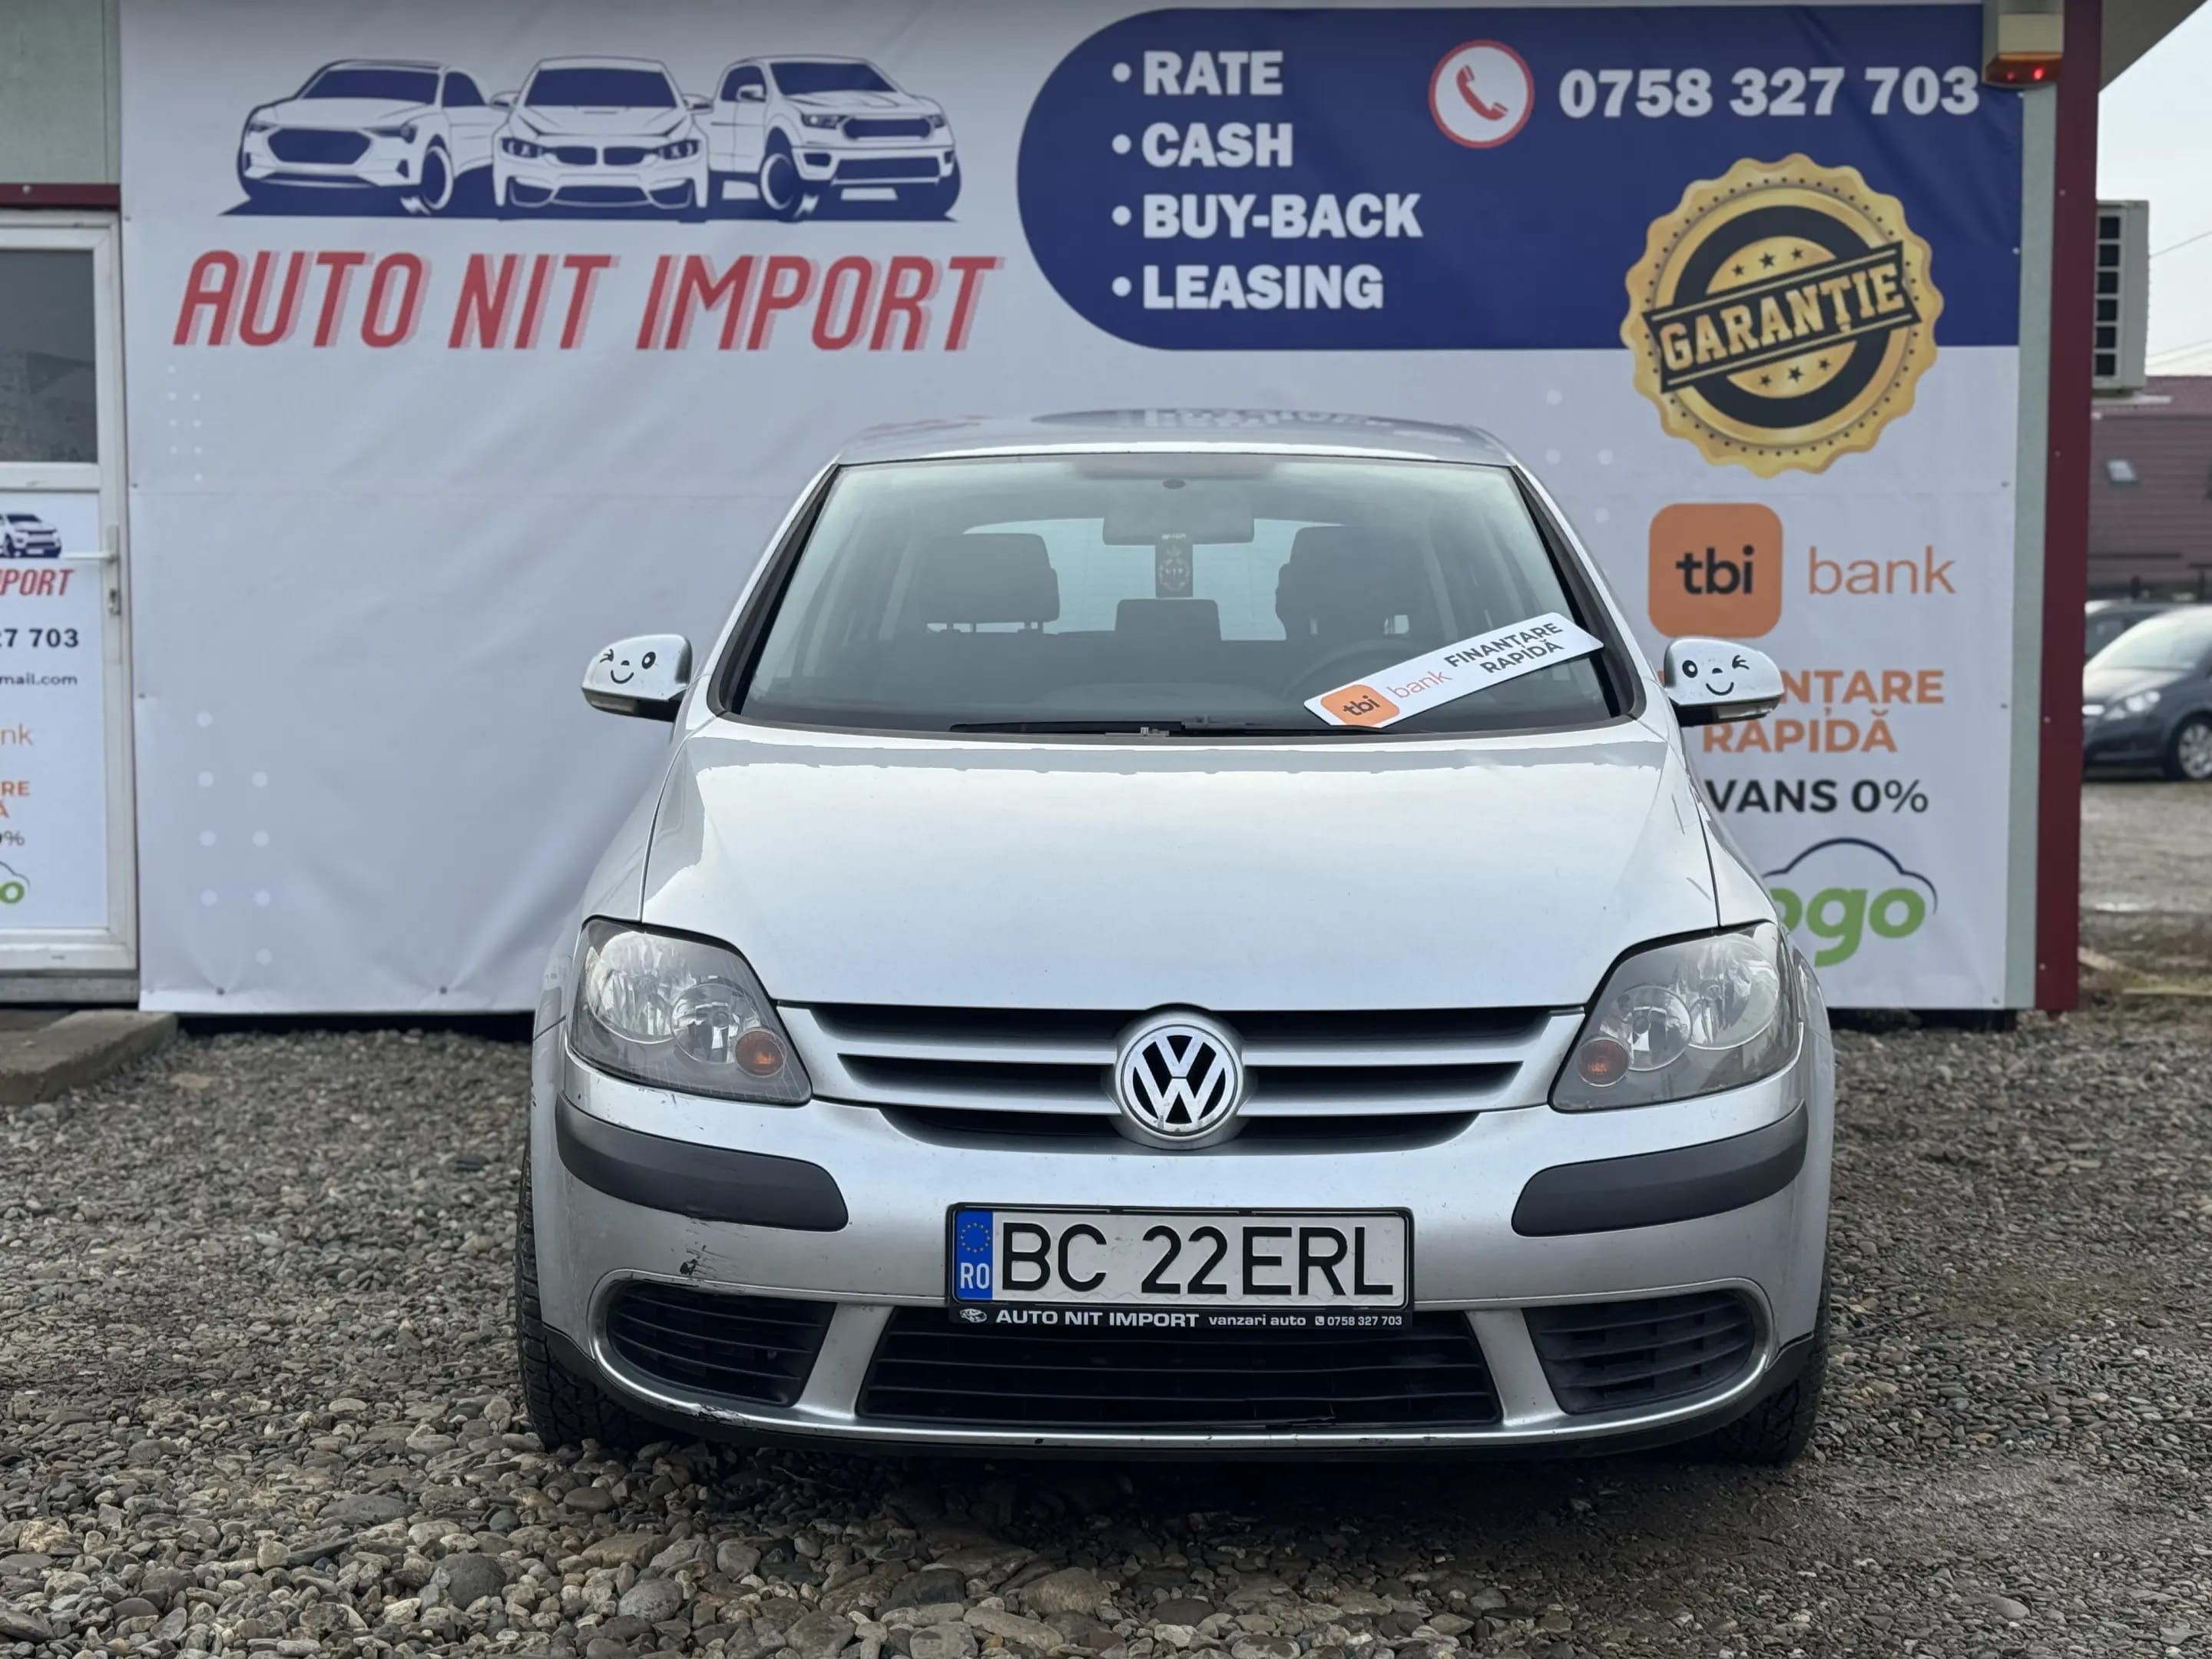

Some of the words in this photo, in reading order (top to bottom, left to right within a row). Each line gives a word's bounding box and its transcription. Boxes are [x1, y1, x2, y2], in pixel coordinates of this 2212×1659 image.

[1143, 51, 1283, 97] RATE
[1558, 68, 1714, 118] 0758
[1729, 68, 1845, 117] 327
[1866, 66, 1979, 116] 703
[1141, 122, 1293, 168] CASH
[1143, 194, 1422, 238] BUY-BACK
[173, 250, 431, 349] AUTO
[448, 255, 621, 349] NIT
[636, 255, 1005, 351] IMPORT
[1143, 263, 1384, 310] LEASING
[0, 568, 75, 596] PORT
[1675, 545, 1755, 595] tbi
[1808, 545, 1956, 594] bank
[28, 628, 79, 648] 703
[1479, 638, 1564, 674] RAPIDĂ
[1343, 694, 1381, 717] tbi
[1387, 670, 1452, 699] bank
[1702, 709, 1898, 753] RAPIDĂ
[1704, 780, 1837, 813] VANS
[1852, 780, 1929, 813] 0%
[960, 1263, 989, 1290] RO
[1002, 1222, 1108, 1292] BC
[995, 1310, 1058, 1325] AUTO
[1065, 1312, 1102, 1325] NIT
[1109, 1313, 1199, 1327] IMPORT
[1208, 1314, 1266, 1326] vanzari
[1270, 1316, 1306, 1326] auto
[1327, 1316, 1355, 1326] 0758
[1358, 1316, 1378, 1326] 327
[1382, 1316, 1402, 1326] 703
